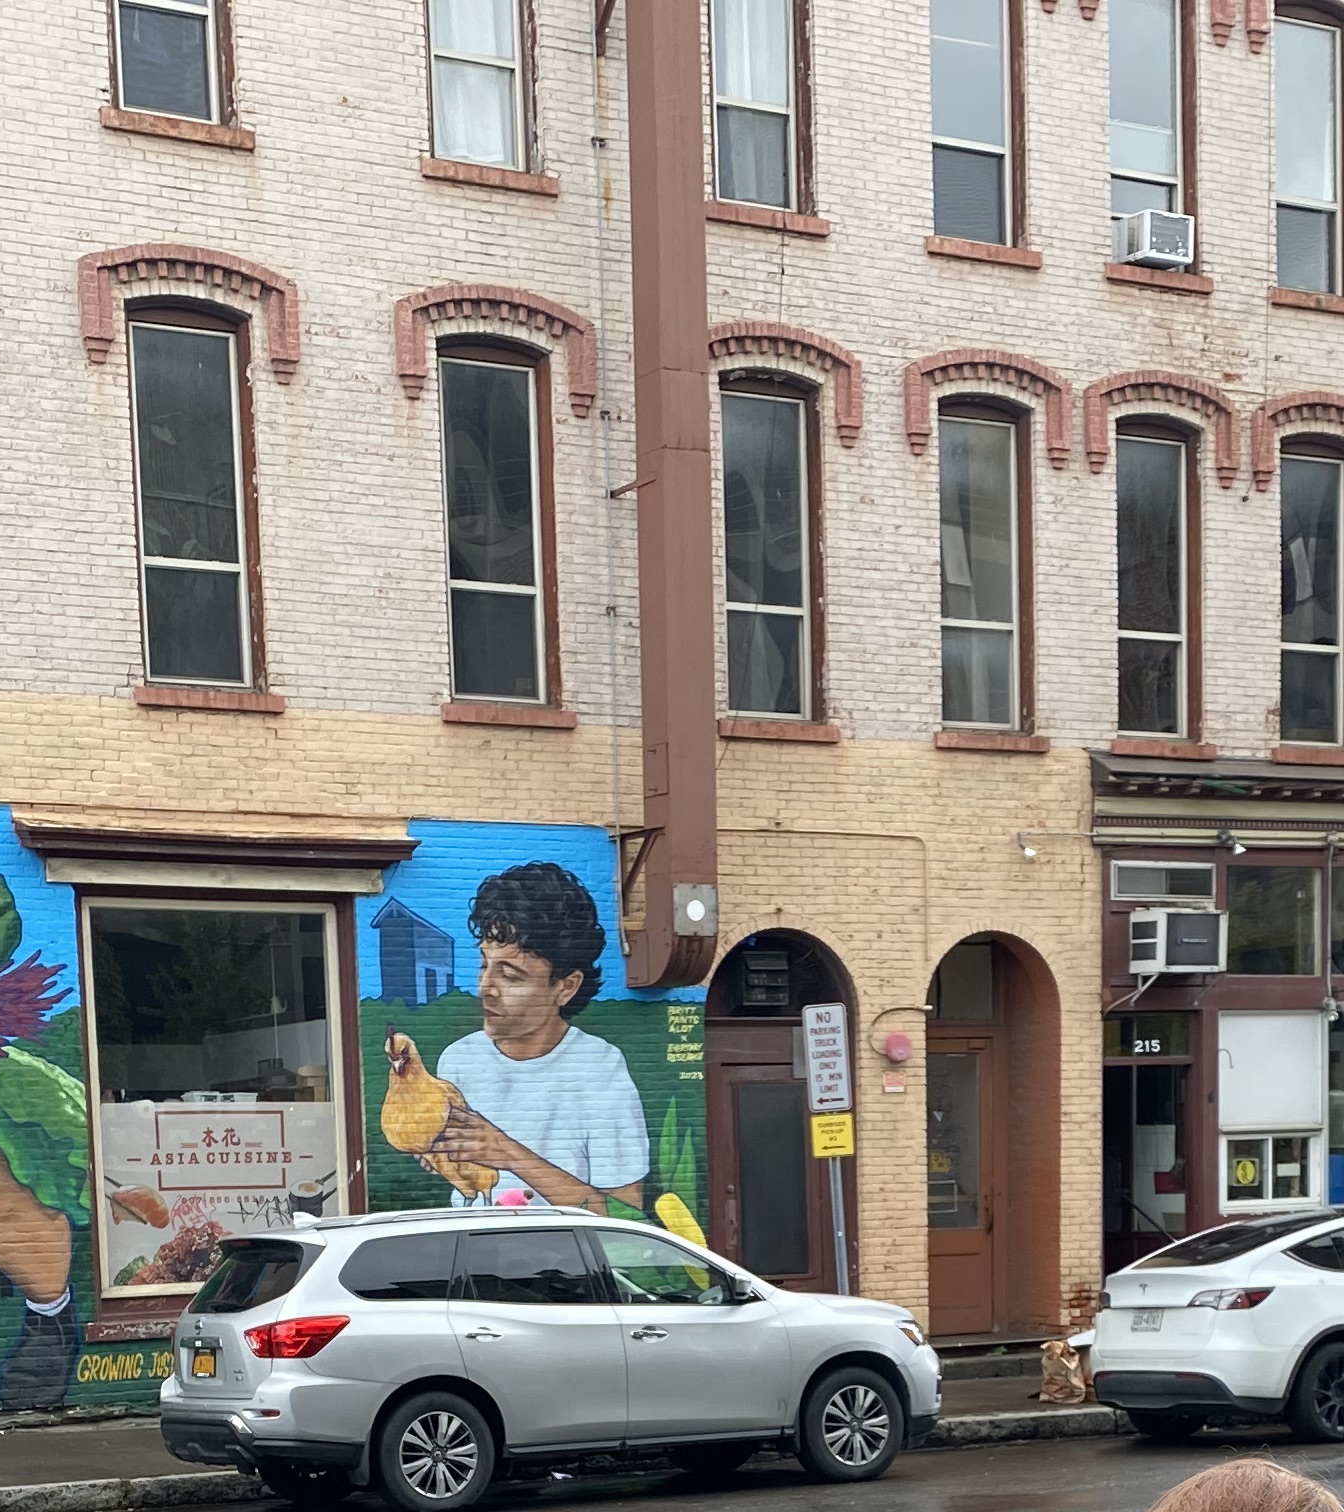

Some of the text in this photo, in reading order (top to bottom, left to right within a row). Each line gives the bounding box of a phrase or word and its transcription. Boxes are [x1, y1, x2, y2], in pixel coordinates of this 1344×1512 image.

[815, 1011, 832, 1024] NO
[809, 1026, 841, 1036] PARKING
[814, 1038, 838, 1048] TRUCK
[1134, 1039, 1161, 1053] 215
[812, 1049, 843, 1060] LOADING
[819, 1062, 837, 1071] ONLY
[816, 1072, 843, 1083] 15 MIN
[820, 1084, 838, 1094] LIMIT
[201, 1126, 241, 1148] 木花
[150, 1151, 293, 1166] ASIA CUISINE
[77, 1352, 144, 1382] GROWING
